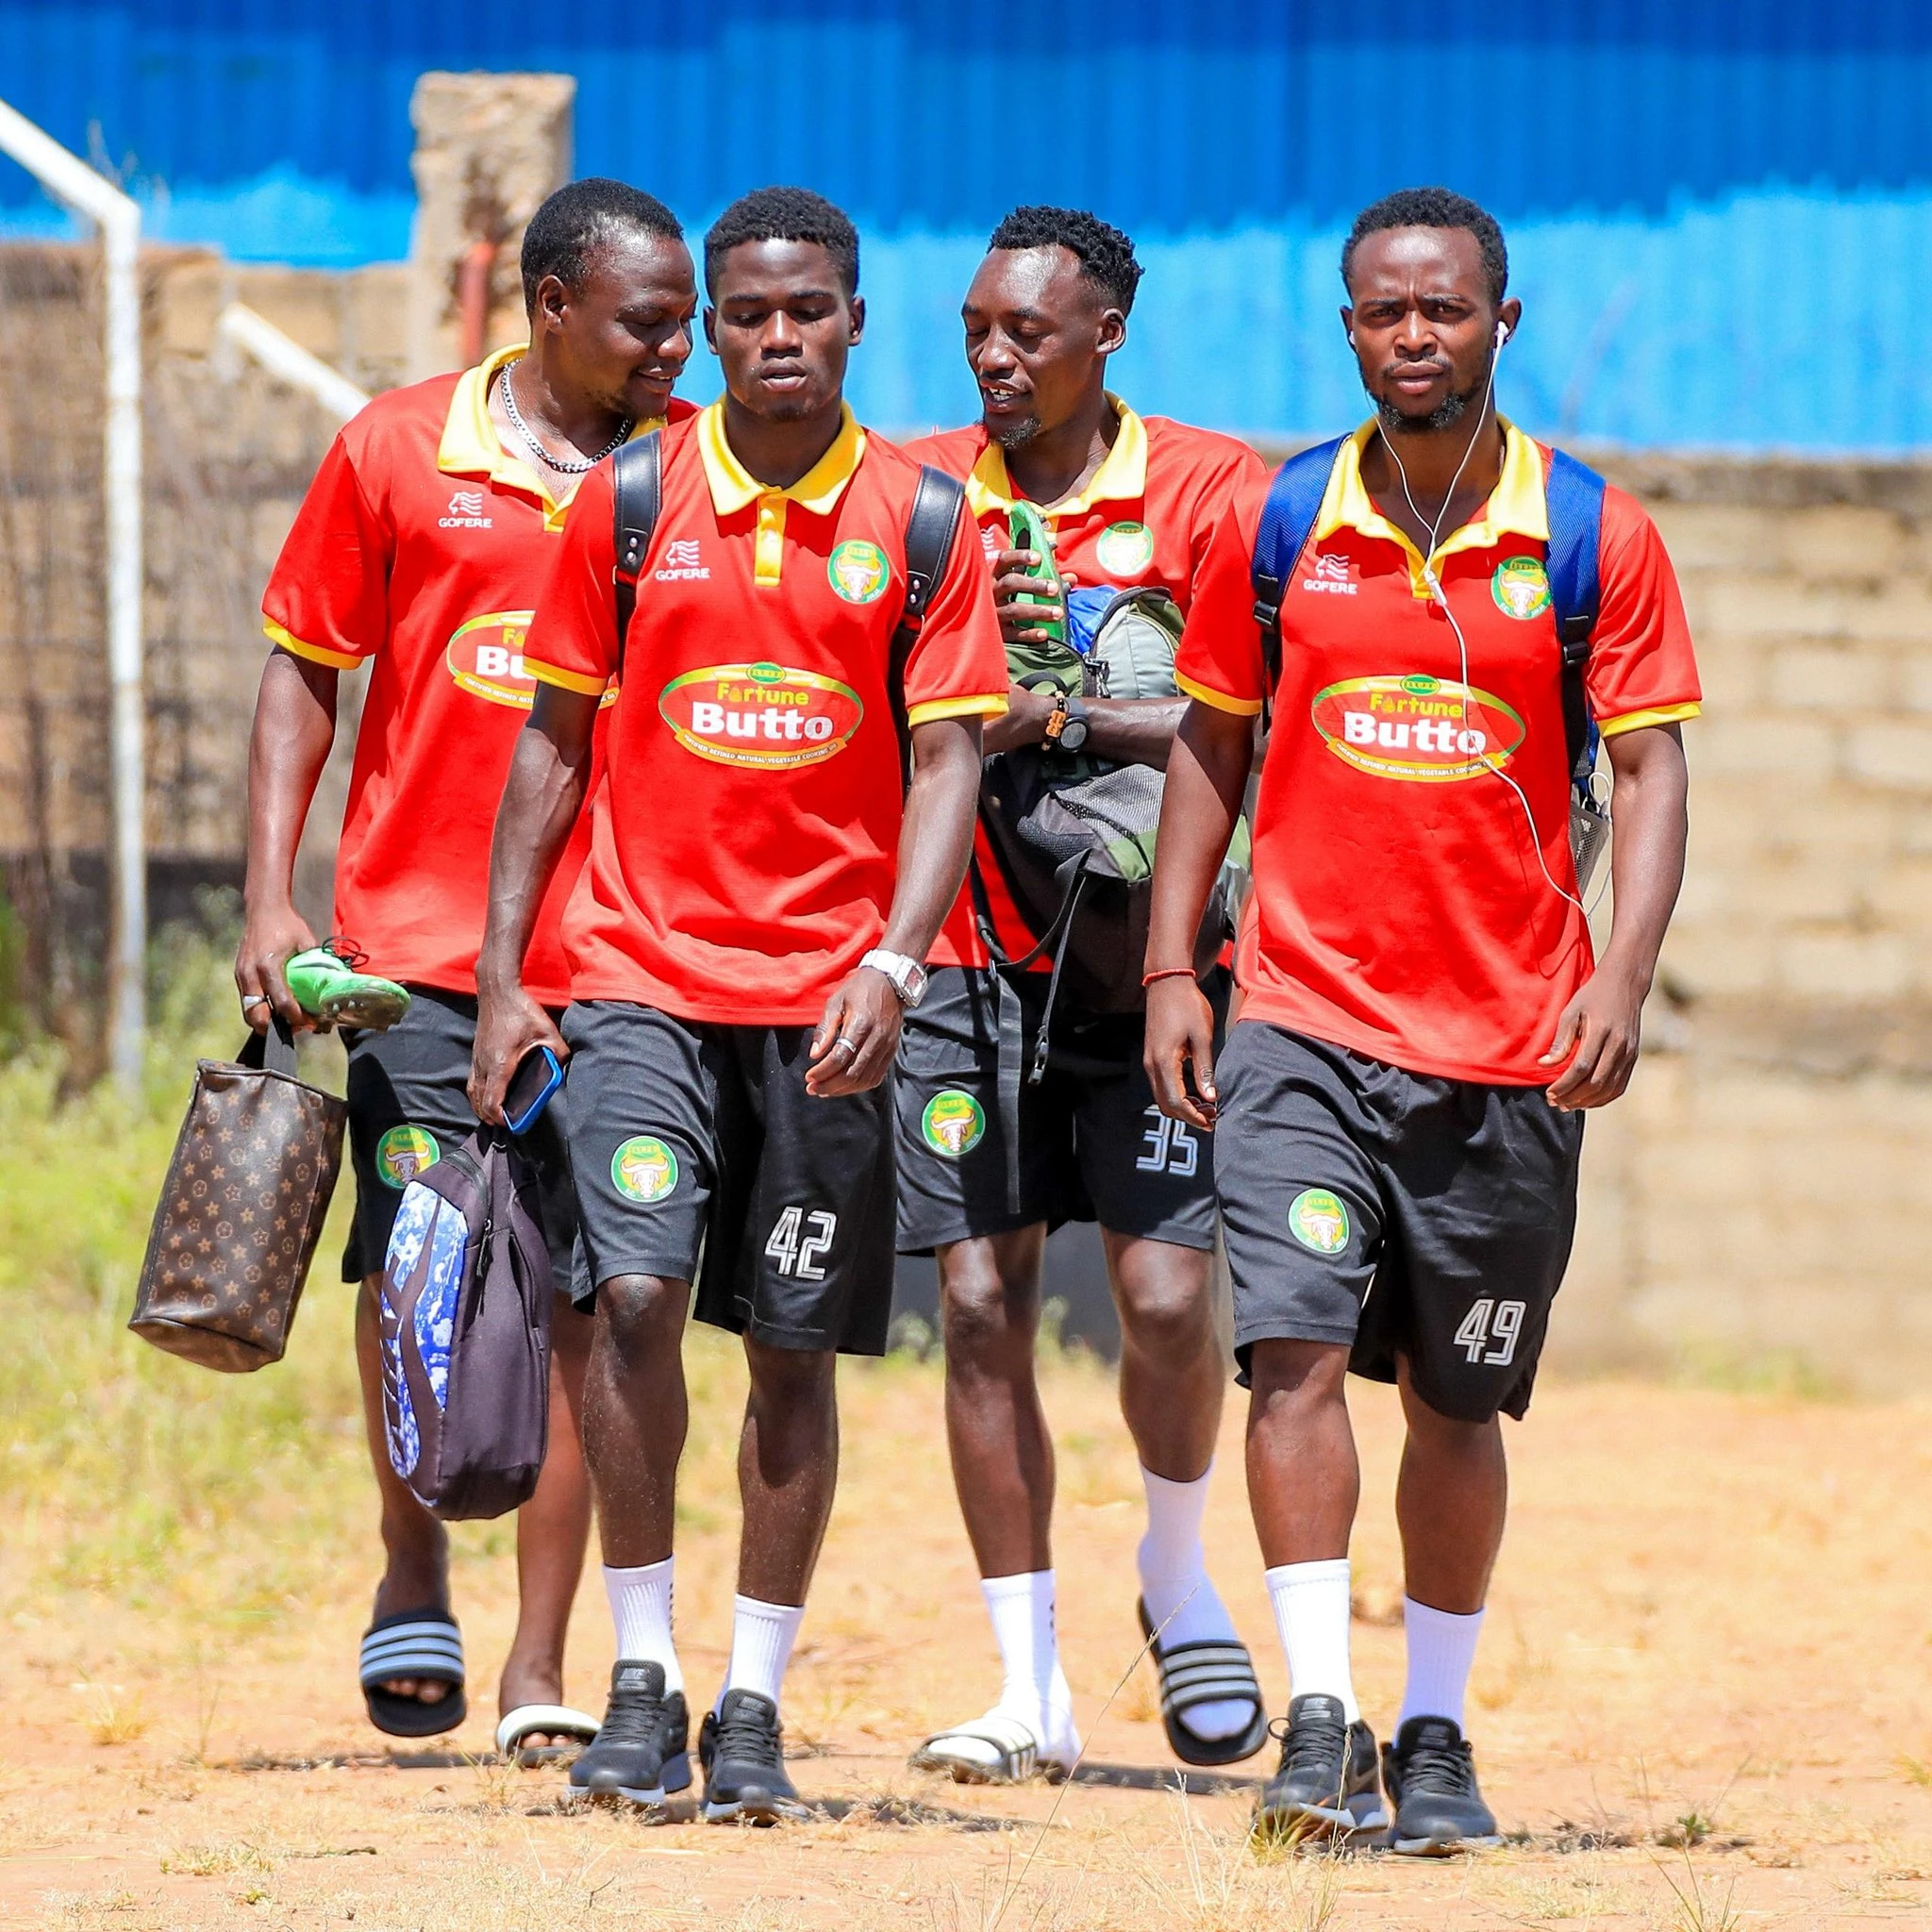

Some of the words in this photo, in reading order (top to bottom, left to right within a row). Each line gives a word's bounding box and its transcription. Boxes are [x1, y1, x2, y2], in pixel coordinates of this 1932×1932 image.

[438, 517, 492, 528] GOFERE
[655, 567, 710, 581] GOFERE
[1303, 578, 1357, 594] GOFERE
[717, 682, 809, 706] Fortune
[1370, 693, 1463, 718] Fortune
[691, 701, 834, 741] Butto
[1343, 710, 1487, 754] Butto
[1136, 1104, 1198, 1176] 35
[765, 1206, 837, 1280] 42
[1453, 1298, 1527, 1367] 49
